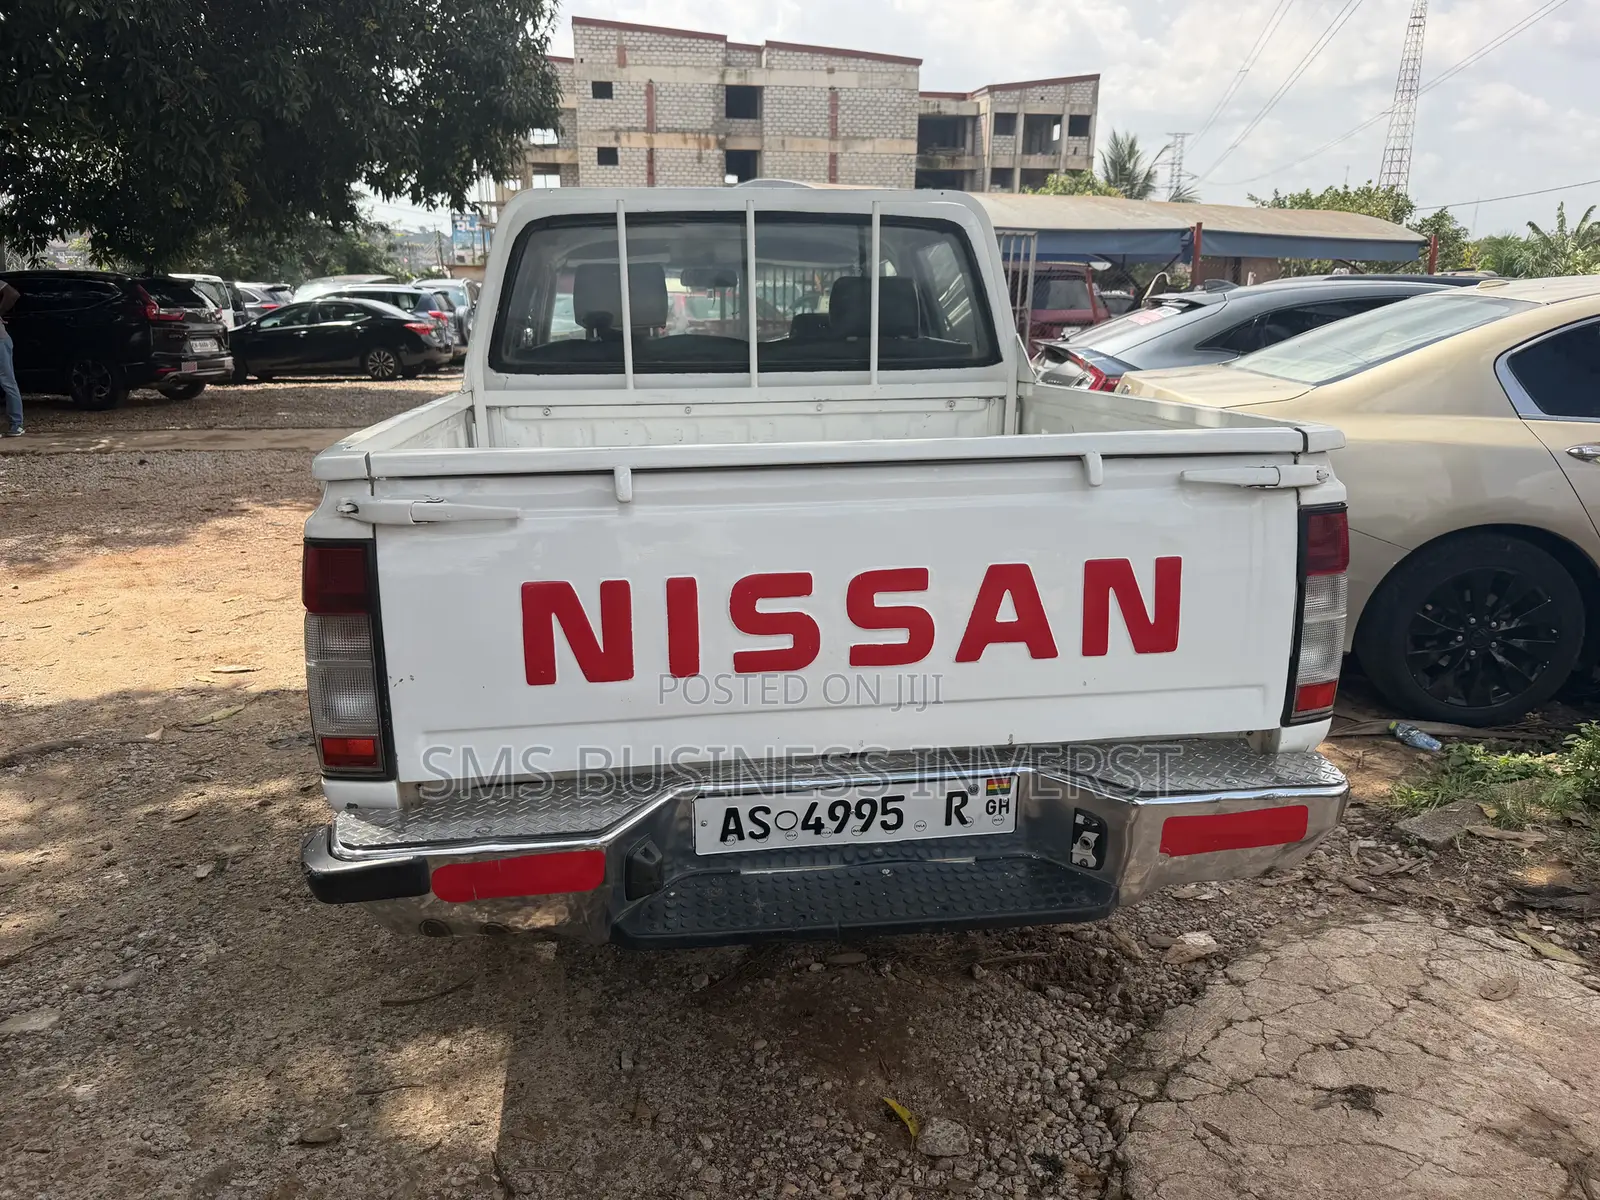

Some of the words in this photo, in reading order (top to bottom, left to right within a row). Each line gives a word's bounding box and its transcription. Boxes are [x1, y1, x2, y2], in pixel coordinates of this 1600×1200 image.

[521, 556, 1182, 686] NISSAN
[720, 805, 771, 842] AS
[801, 795, 905, 835] 4995
[945, 791, 969, 826] R
[985, 798, 1010, 815] GH
